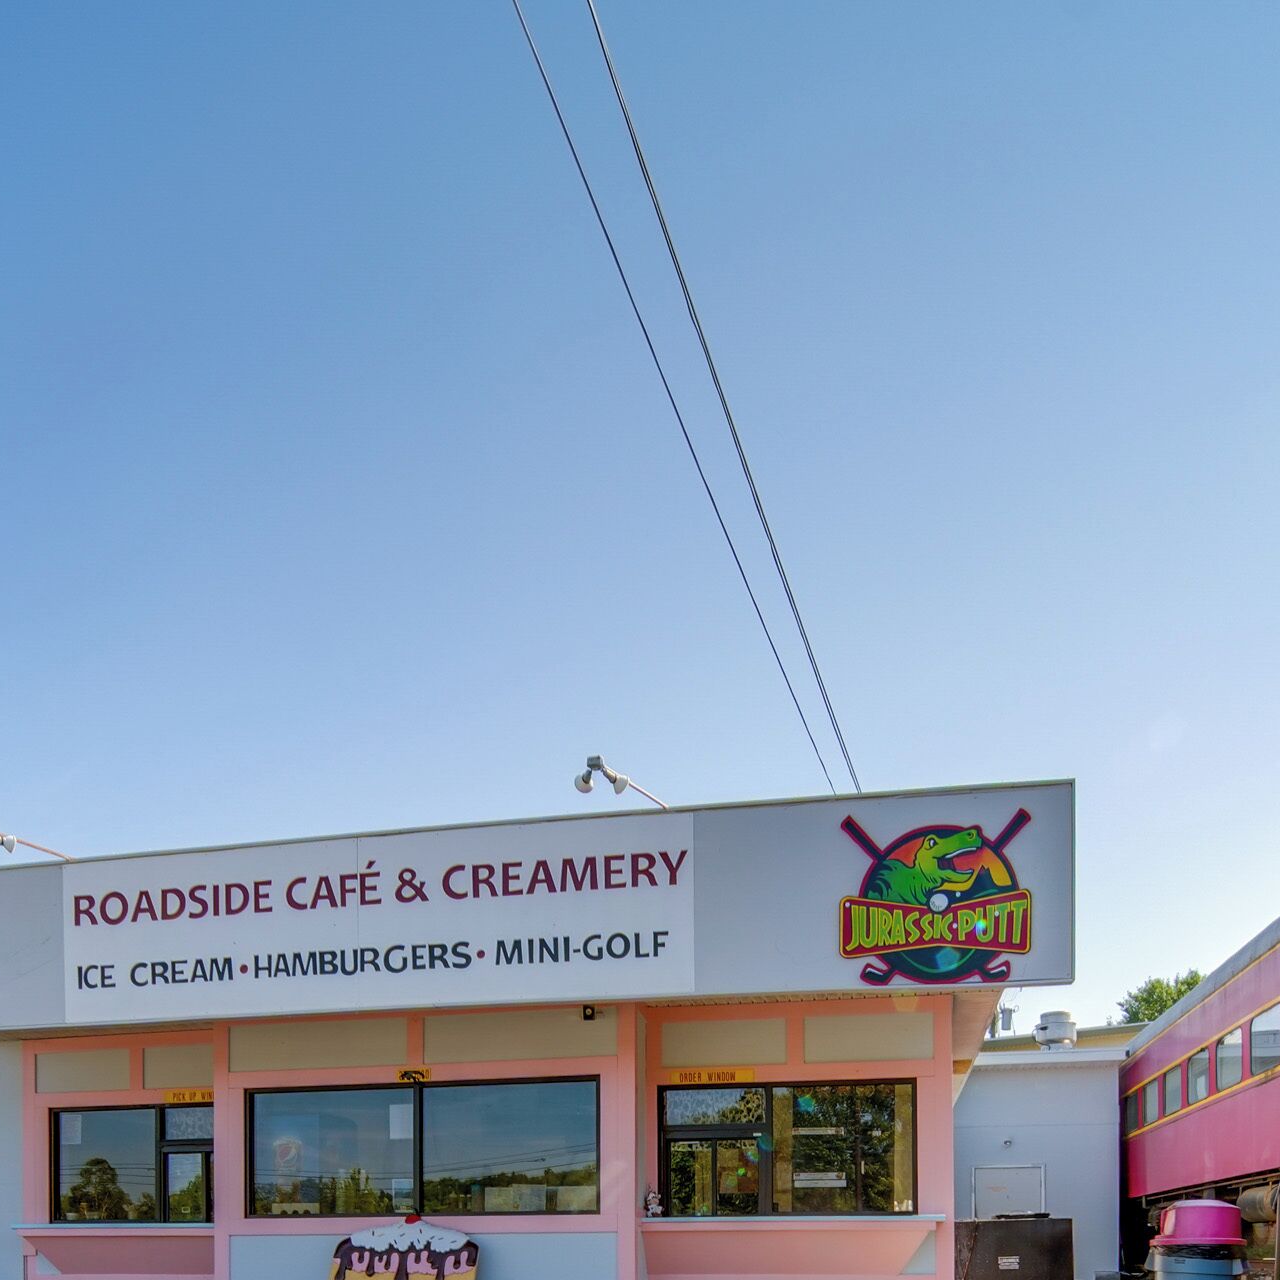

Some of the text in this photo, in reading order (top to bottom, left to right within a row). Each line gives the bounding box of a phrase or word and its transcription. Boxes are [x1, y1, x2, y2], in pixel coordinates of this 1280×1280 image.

[73, 850, 688, 927] ROADSIDE CAFÉ & CREAMERY
[845, 899, 1028, 951] JURASSIC PUTT
[77, 931, 669, 990] ICE CREAM HAMBURGERS MINI-GOLF
[172, 1090, 215, 1102] PICK UP WIN
[679, 1071, 736, 1083] ORDER WINDOW
